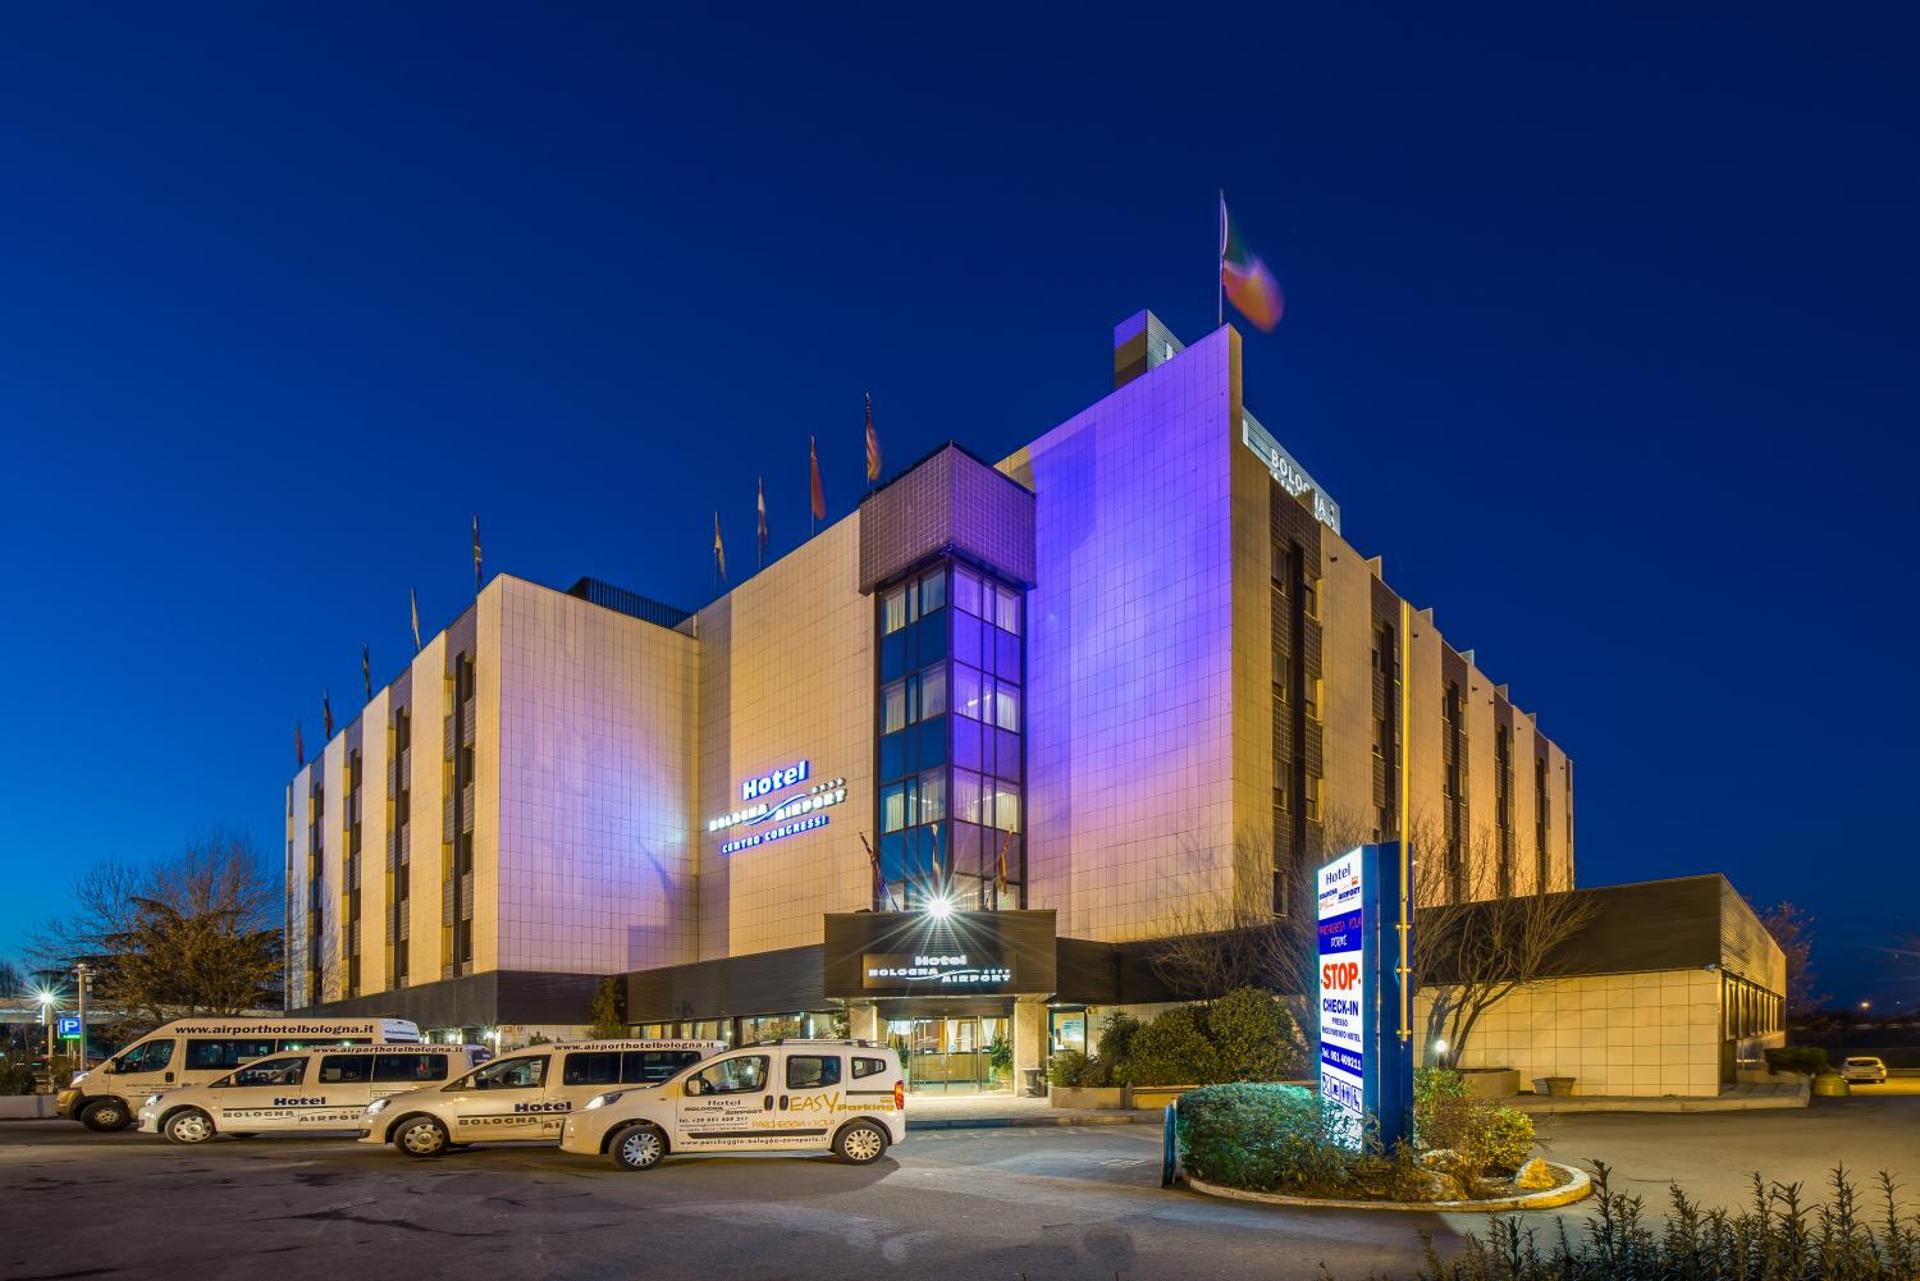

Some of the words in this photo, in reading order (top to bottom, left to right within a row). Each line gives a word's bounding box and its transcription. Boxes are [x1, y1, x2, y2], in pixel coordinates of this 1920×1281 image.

[743, 760, 808, 799] Hotel
[709, 803, 768, 832] BOLOGNA
[775, 788, 846, 821] AIRPORT
[722, 837, 761, 854] CENTRO
[765, 816, 829, 842] CONGRESSI
[1325, 863, 1351, 885] Hotel
[914, 955, 967, 966] Hotel
[868, 968, 938, 977] BOLOGNA
[941, 974, 1011, 983] AIRPORT
[1322, 962, 1359, 990] STOP
[1322, 998, 1359, 1016] CHECK-IN
[64, 1020, 78, 1032] P
[175, 1024, 374, 1035] www.airporthotelbologna.it
[313, 1045, 464, 1054] www.airporthotelbologna.it
[554, 1041, 715, 1051] www.airporthotelbologna.it
[274, 1097, 326, 1106] Hotel
[514, 1101, 572, 1112] Hotel
[789, 1092, 840, 1114] EASY
[222, 1110, 295, 1118] BOLOGNA
[300, 1114, 360, 1122] AIRPOR
[458, 1117, 538, 1126] BOLOGNA
